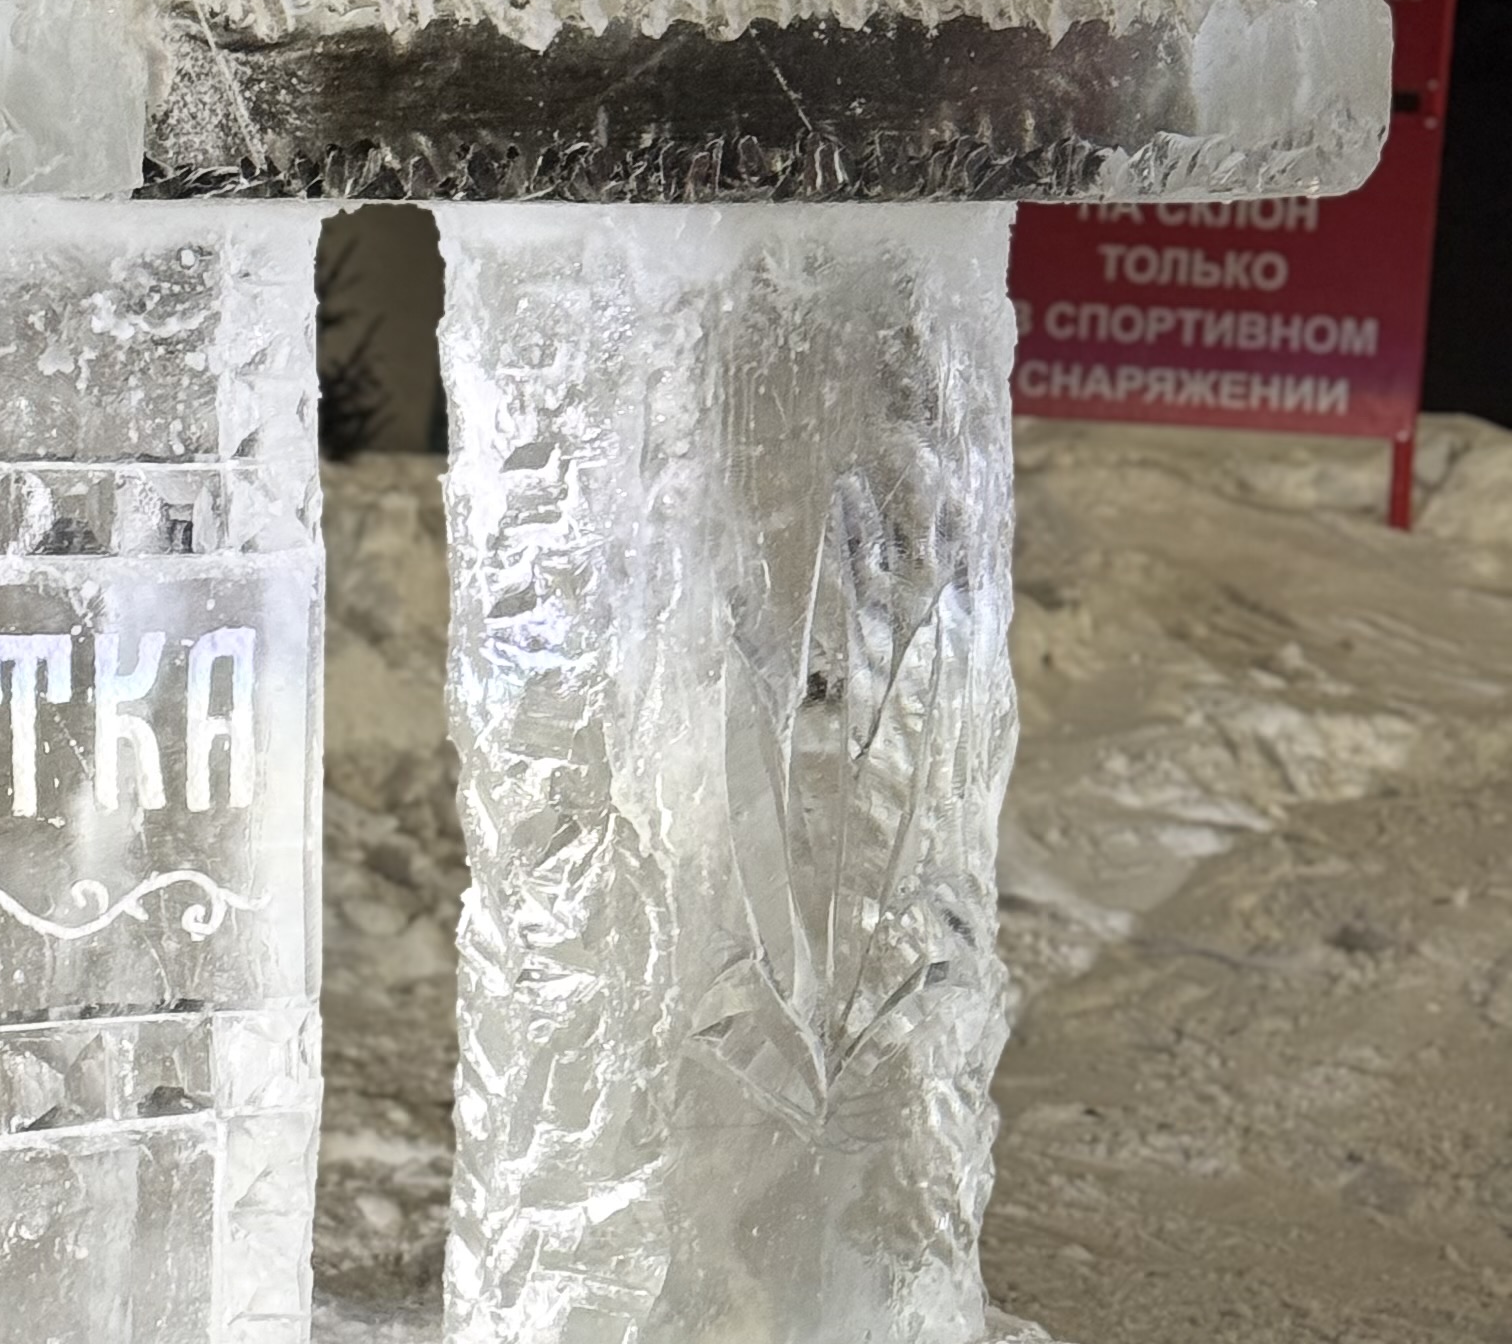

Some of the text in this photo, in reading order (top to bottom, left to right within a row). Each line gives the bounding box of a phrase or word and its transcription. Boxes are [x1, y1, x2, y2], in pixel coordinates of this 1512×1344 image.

[1100, 245, 1288, 291] ТОЛЬКО
[1045, 302, 1378, 355] СПОРТИВНОМ
[1018, 361, 1349, 415] СНАРЯЖЕНИИ
